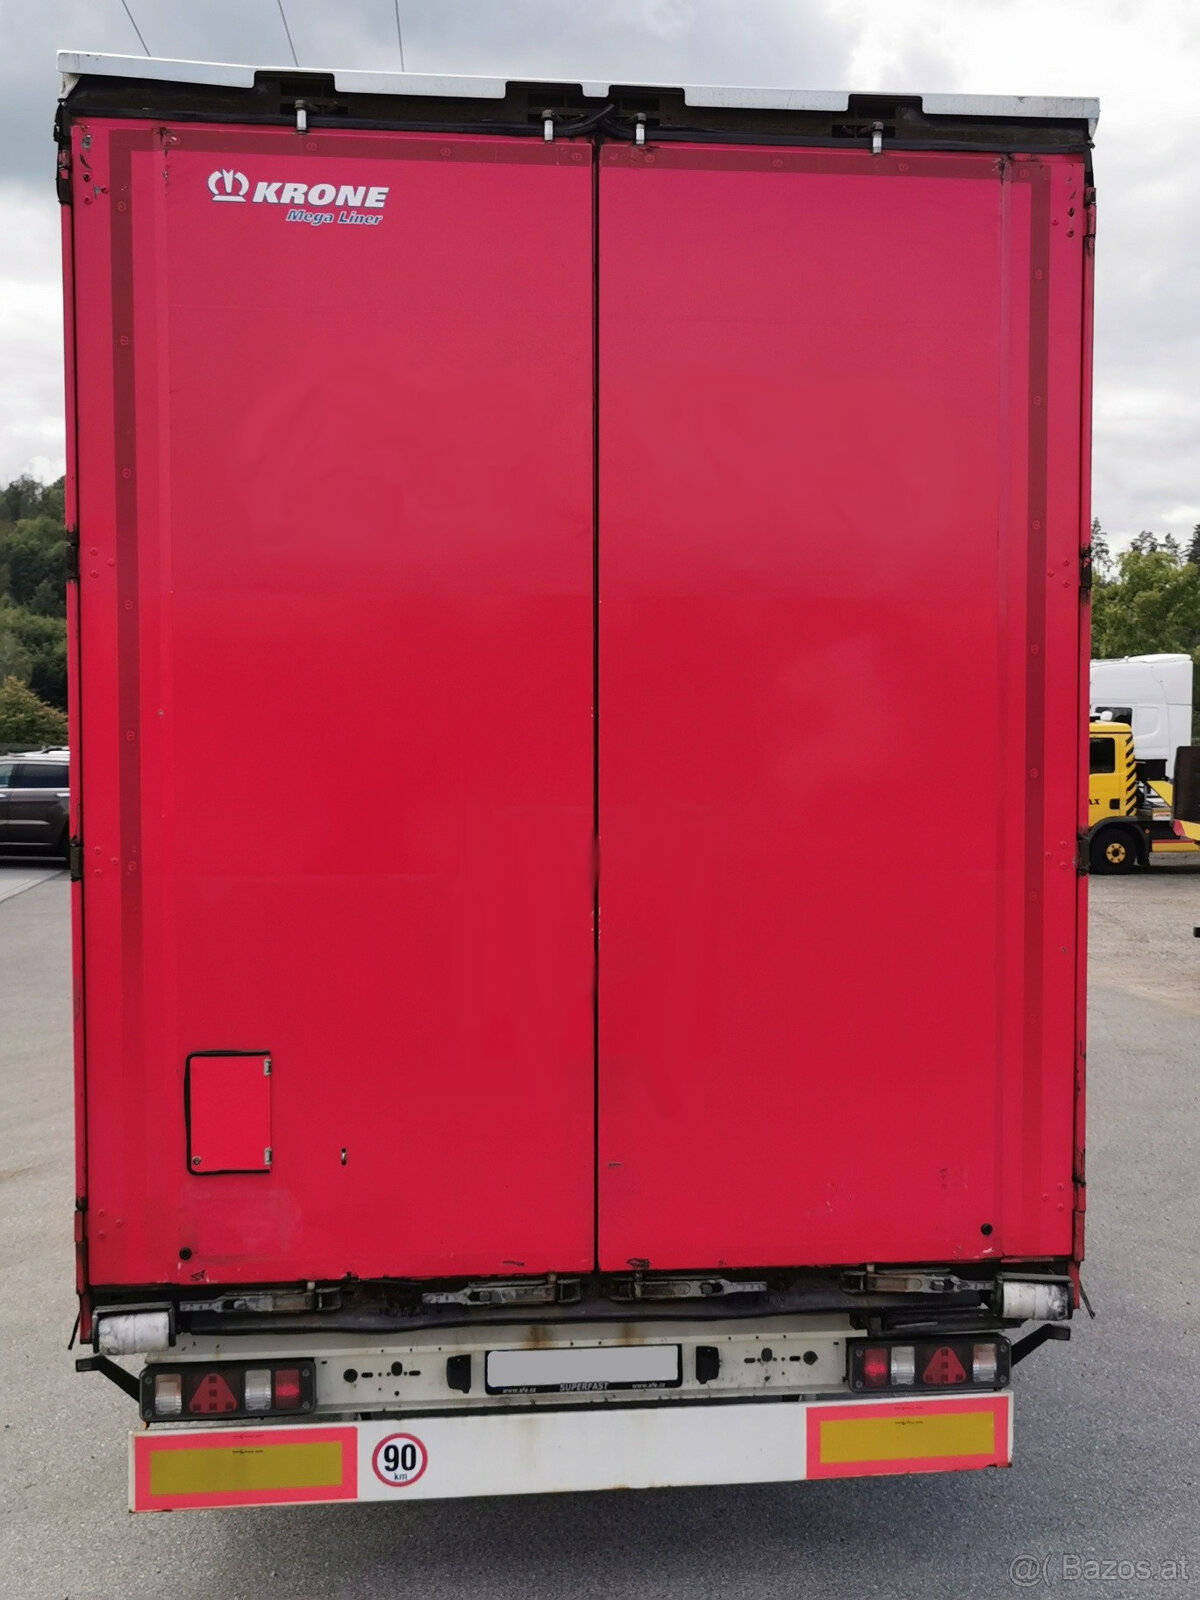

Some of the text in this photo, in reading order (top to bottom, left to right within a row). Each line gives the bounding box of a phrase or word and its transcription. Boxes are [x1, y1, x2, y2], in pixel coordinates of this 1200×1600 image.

[252, 182, 389, 208] KRONE
[286, 209, 382, 226] Mega Liner
[559, 1382, 609, 1392] SUPERFAST
[384, 1443, 416, 1471] 90
